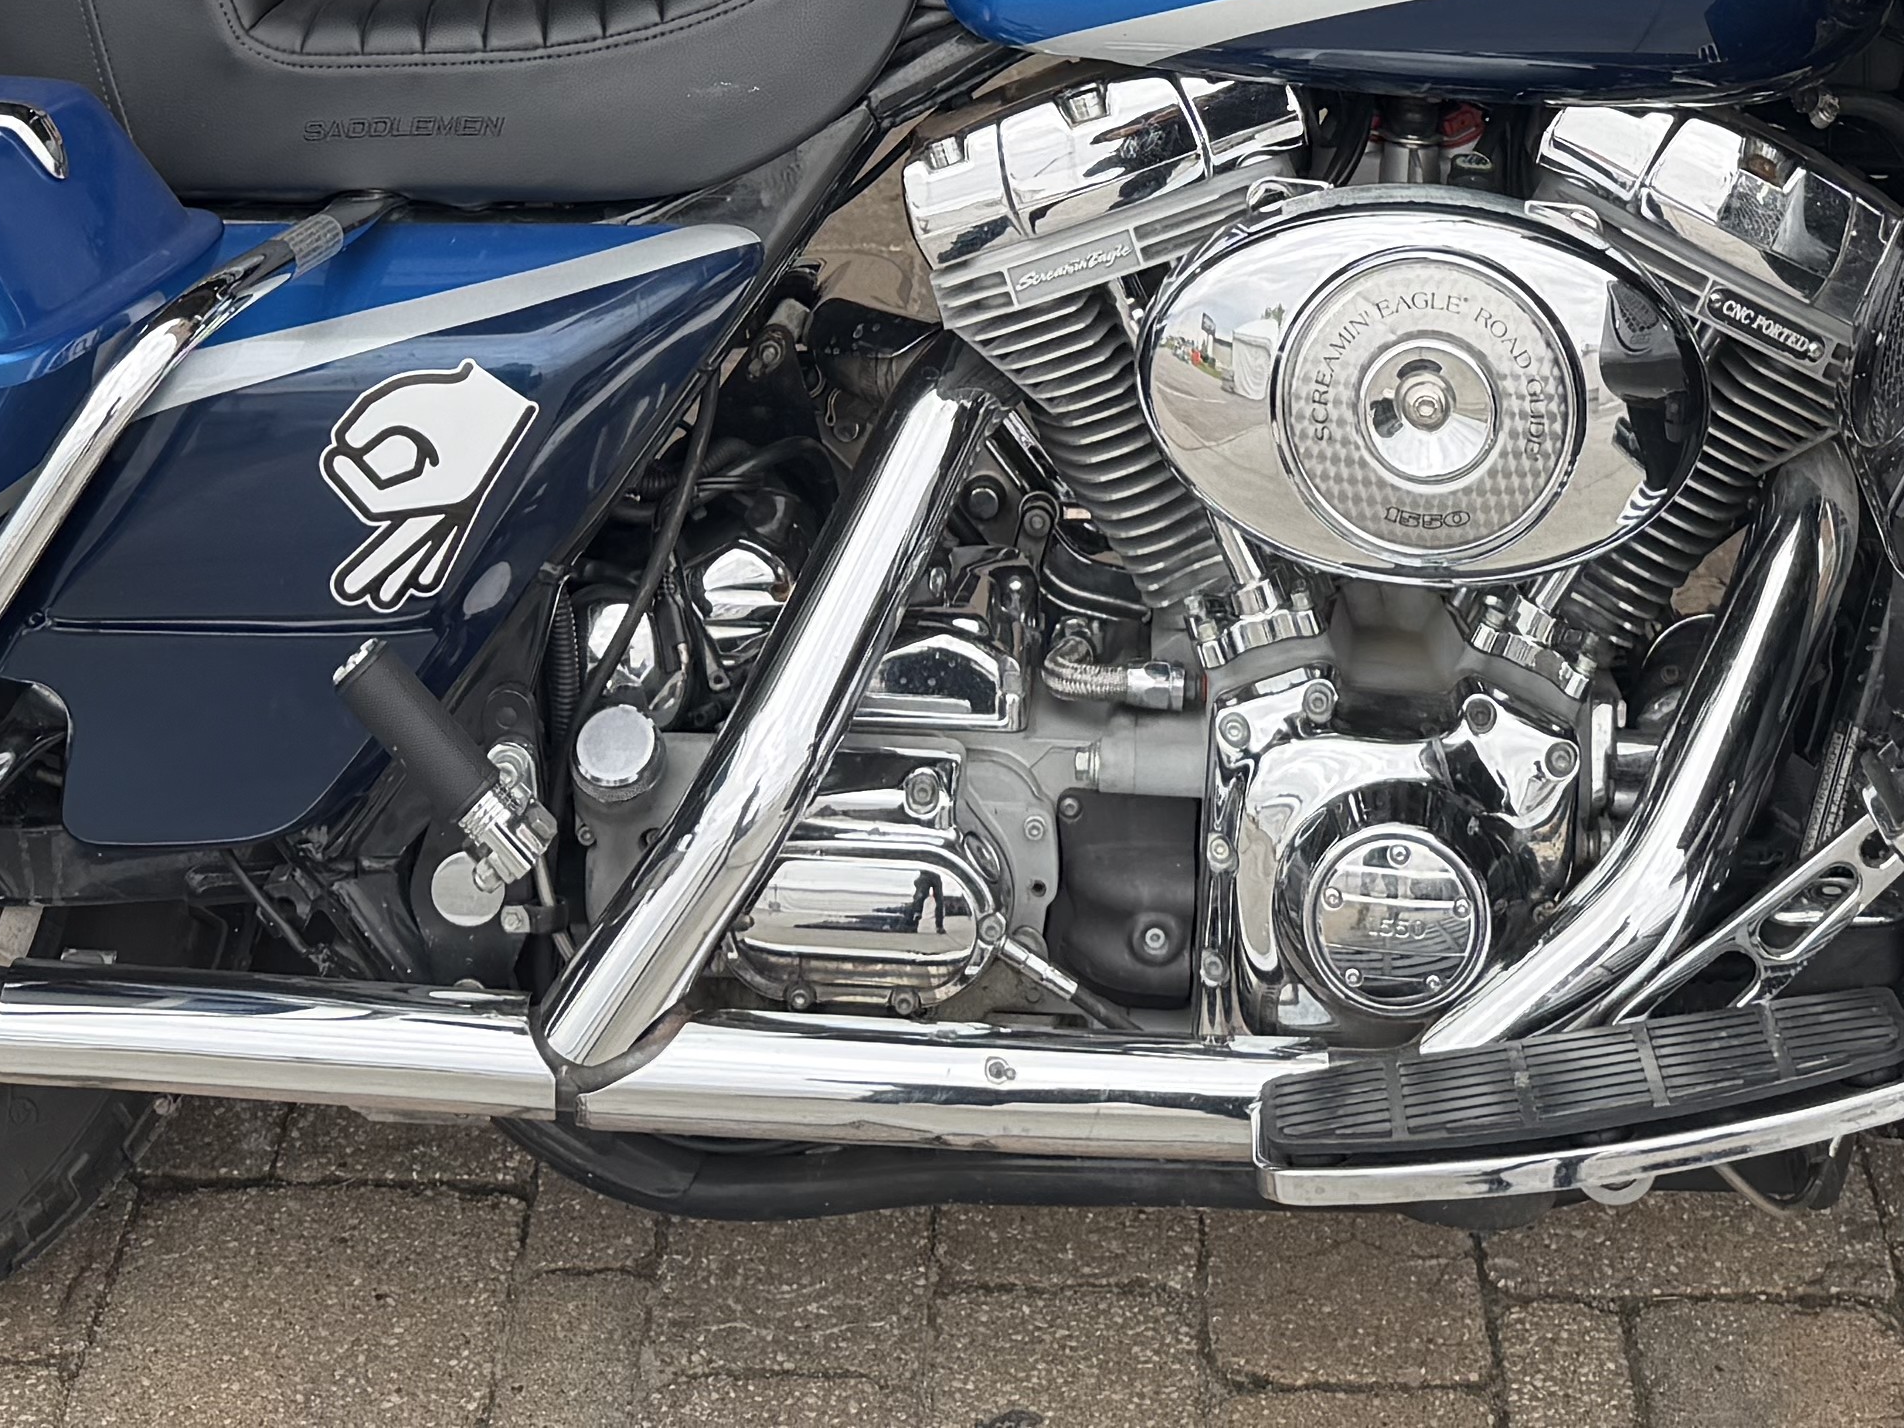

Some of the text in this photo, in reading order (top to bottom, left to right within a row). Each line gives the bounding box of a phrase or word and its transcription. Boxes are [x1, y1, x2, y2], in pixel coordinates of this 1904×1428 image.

[302, 115, 506, 143] SADDLEMEN
[1473, 306, 1532, 370] ROAD
[1722, 299, 1810, 353] CNC PORTED
[1383, 505, 1471, 530] 1550
